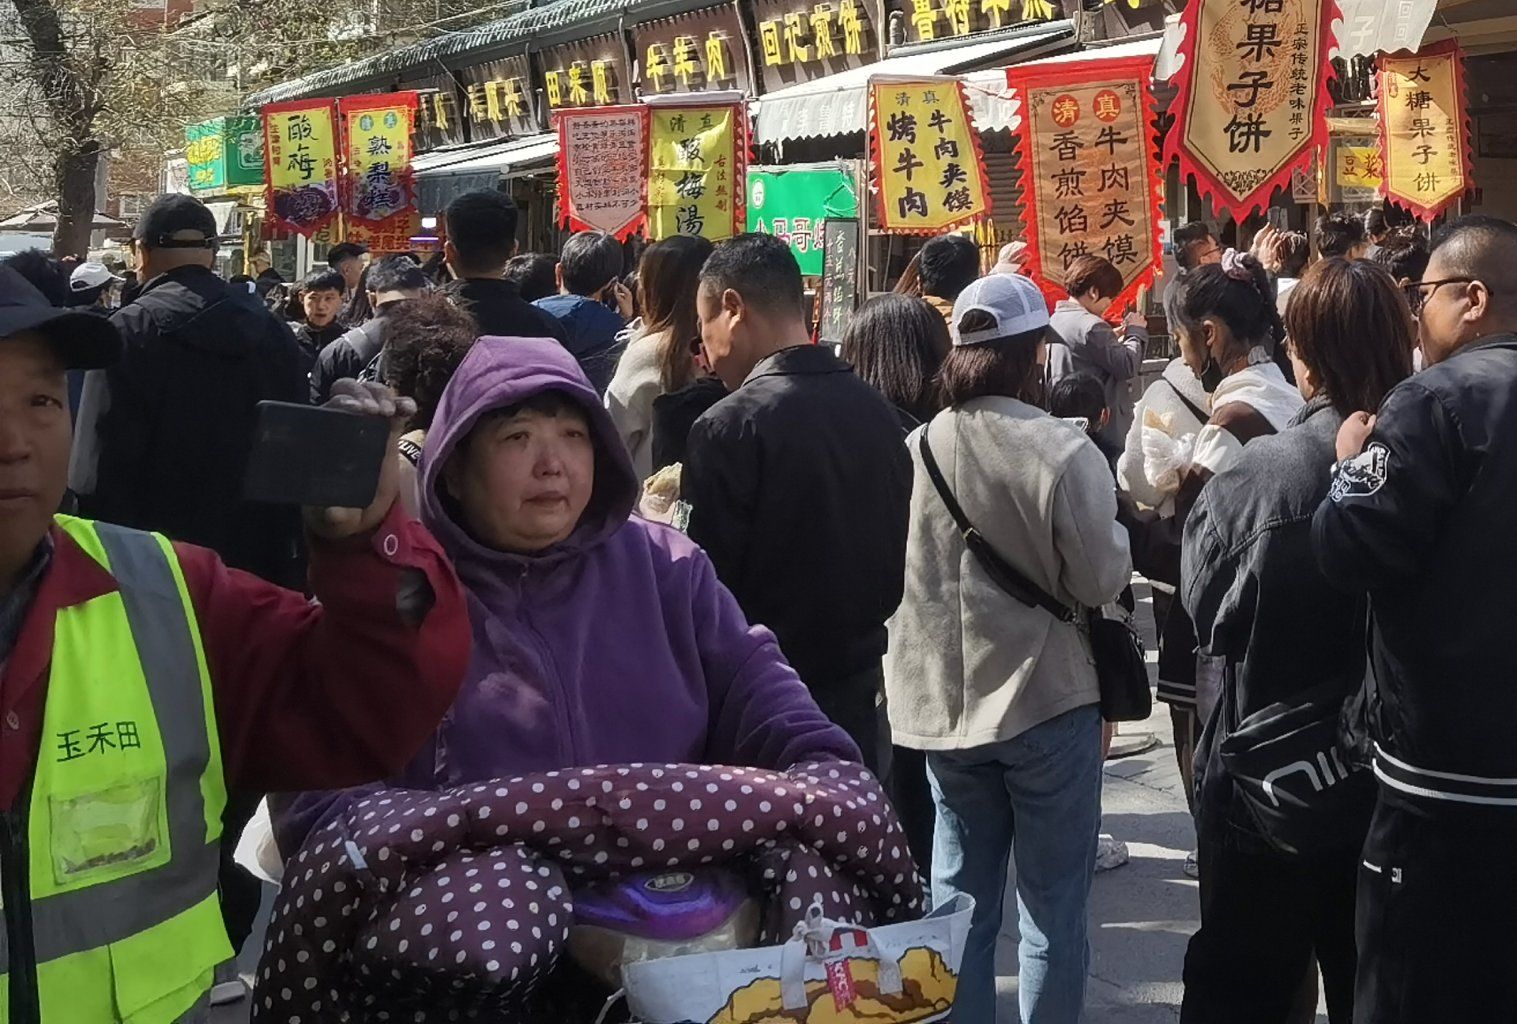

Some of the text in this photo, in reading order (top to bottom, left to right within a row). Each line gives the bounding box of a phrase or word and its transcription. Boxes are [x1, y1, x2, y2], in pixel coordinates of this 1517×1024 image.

[646, 36, 725, 93] 牛羊肉
[895, 90, 940, 107] 清真
[1053, 94, 1120, 124] 清真
[1288, 23, 1309, 140] 正宗传统老味果子
[887, 113, 928, 219] 烤牛肉
[927, 109, 975, 213] 牛肉夹馍
[1405, 66, 1441, 192] 大糖果子饼
[1049, 131, 1093, 270] 香煎馅饼
[1094, 126, 1139, 265] 牛肉夹馍
[56, 721, 141, 763] 玉禾田
